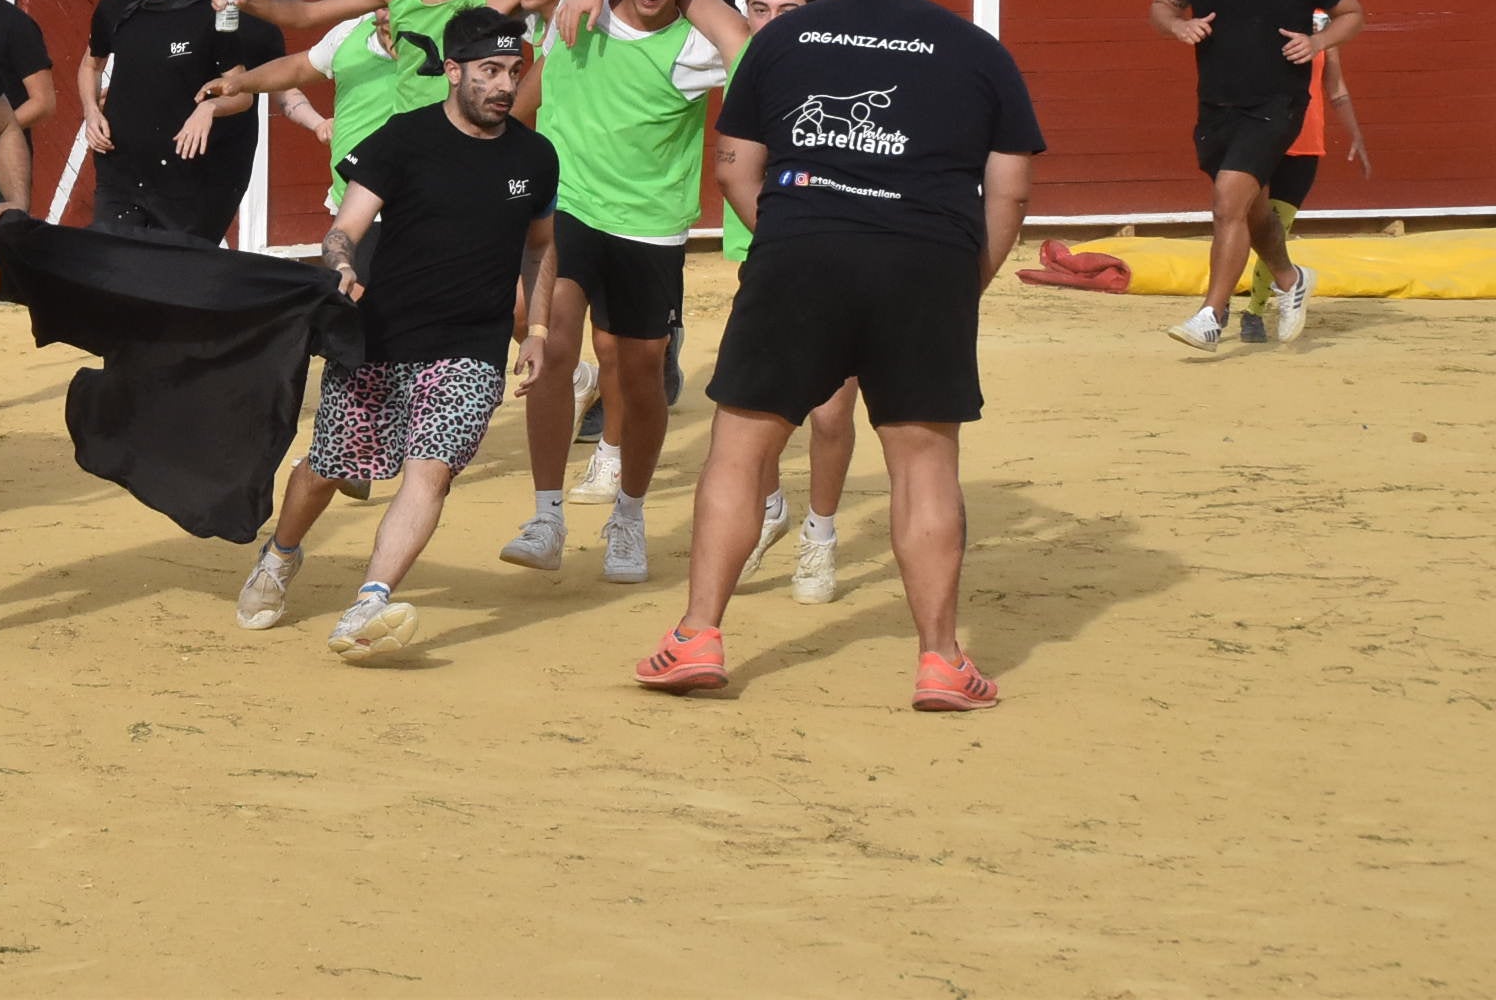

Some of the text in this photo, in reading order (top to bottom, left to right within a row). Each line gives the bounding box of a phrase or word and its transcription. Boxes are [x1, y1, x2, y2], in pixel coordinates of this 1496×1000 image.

[170, 42, 190, 54] BSF
[799, 31, 935, 54] ORGANIZACIÓN
[792, 128, 905, 156] Castellano
[508, 179, 530, 195] BSF
